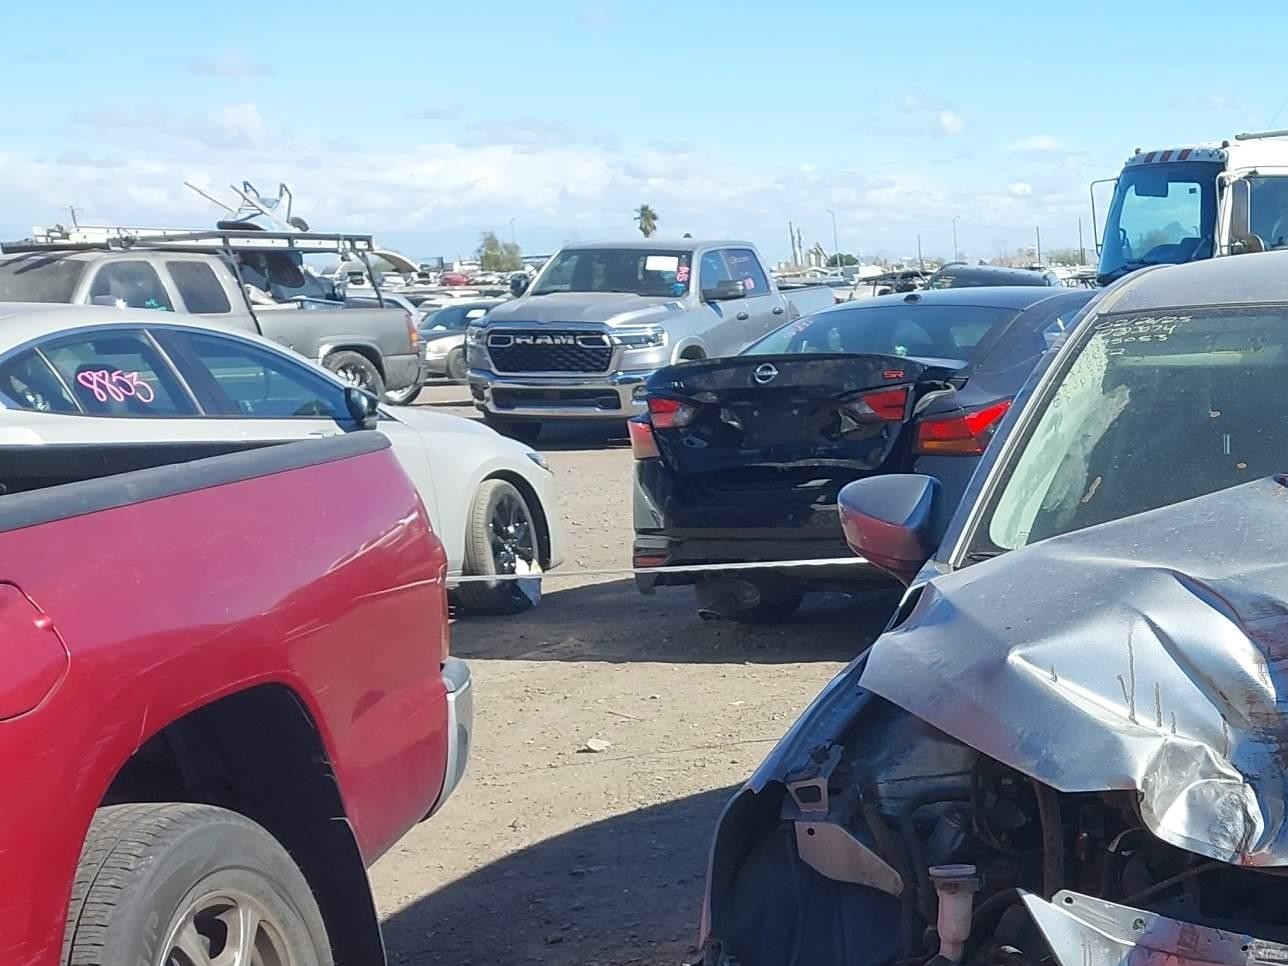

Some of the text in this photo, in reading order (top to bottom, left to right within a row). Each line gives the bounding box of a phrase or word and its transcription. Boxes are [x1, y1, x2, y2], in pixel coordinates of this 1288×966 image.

[515, 335, 575, 345] RAM
[883, 371, 905, 379] SR
[77, 370, 154, 402] 8853
